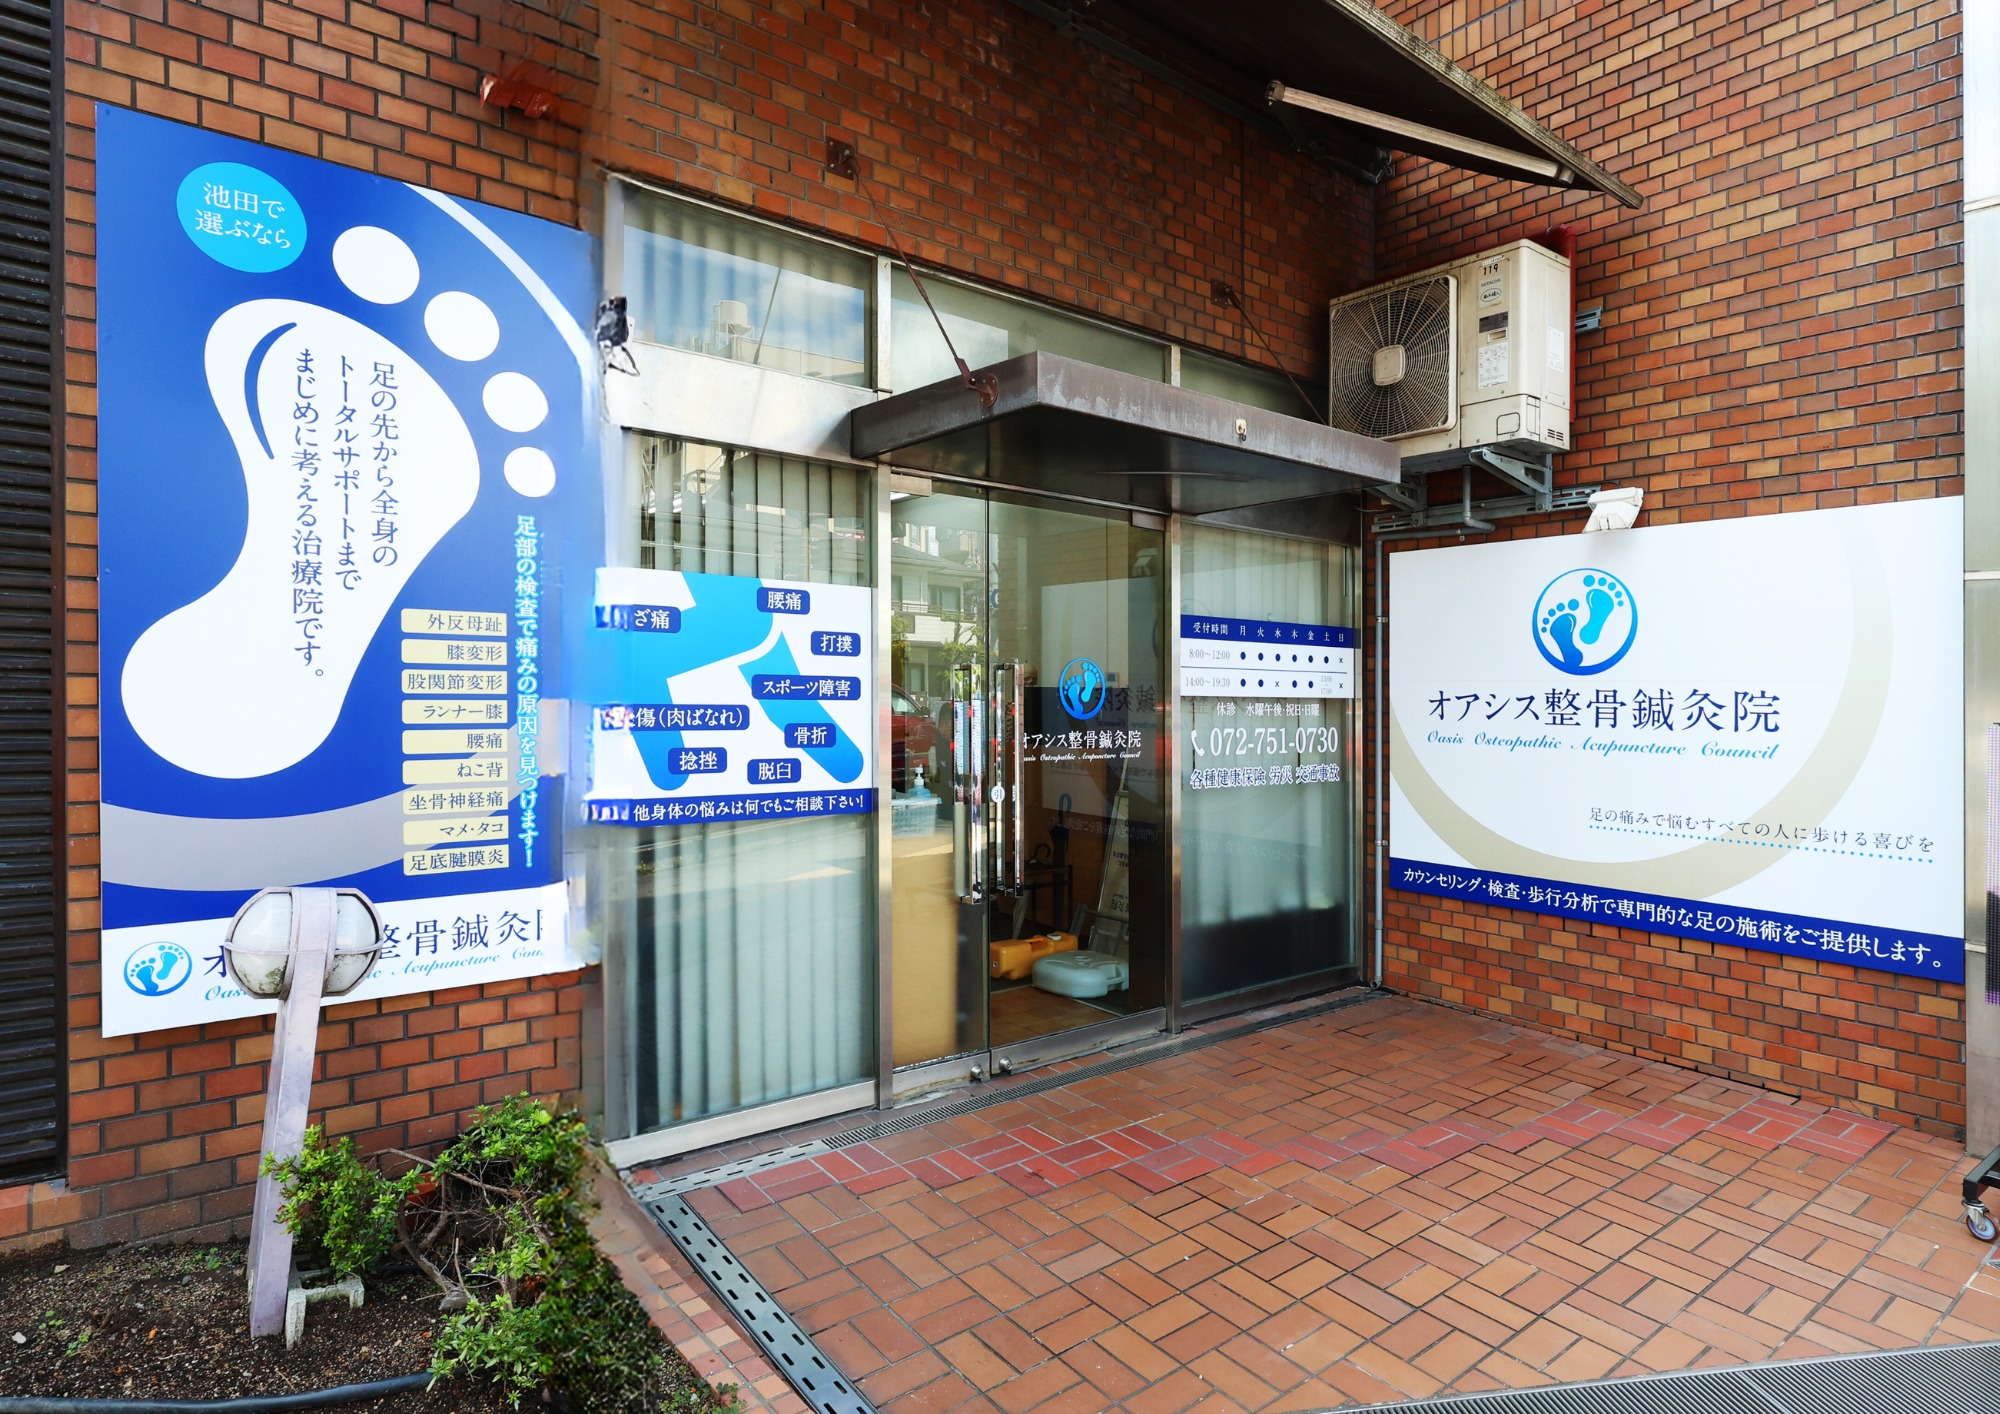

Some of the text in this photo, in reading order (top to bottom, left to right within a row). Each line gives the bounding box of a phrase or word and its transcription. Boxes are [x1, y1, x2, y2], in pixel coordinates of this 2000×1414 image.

[203, 181, 286, 217] 池田で
[195, 208, 292, 249] 選ぶなら
[331, 354, 362, 591] トータルサポートまで
[369, 361, 400, 567] 足の先から全身の
[291, 348, 324, 677] まじめに考える治療院です。
[766, 591, 802, 611] 腰痛
[427, 613, 502, 632] 外反母趾
[632, 608, 670, 630] ざ痛
[1193, 621, 1344, 643] 受付時間 月 火 水 木 金 土 日
[447, 644, 503, 662] 膝変形
[820, 633, 853, 653] 打撲
[407, 673, 503, 691] 股関節変形
[514, 514, 539, 868] 足部の検査で痛みの原因を見つけます！
[762, 679, 851, 698] スポーツ障害
[423, 703, 503, 721] ランナー膝
[633, 707, 743, 728] 傷（肉ばなれ）
[1216, 702, 1236, 716] 休診
[1245, 702, 1320, 717] 水曜午後・祝日・日曜
[1428, 687, 1780, 733] オアシス整骨鍼灸院
[466, 732, 503, 750] 腰痛
[793, 726, 828, 746] 骨折
[1023, 729, 1142, 750] オアシス整骨鍼灸院
[1210, 726, 1339, 757] 072-751-0730
[1427, 730, 1780, 760] Oasis Osteopathic Acupuncture Council
[679, 750, 718, 771] 捻挫
[1023, 750, 1142, 764] asis Osteopathic Acupuncture Council
[457, 761, 503, 778] ねこ背
[758, 762, 793, 781] 脱臼
[1190, 763, 1340, 789] 各種健康保険 労災 交通事故
[409, 791, 503, 810] 坐骨神経痛
[633, 793, 865, 822] 他身体の悩みは何でもご相談下さい！
[439, 822, 504, 837] マメ・タコ
[1588, 806, 1934, 853] 足の痛みで悩むすべての人に歩ける喜びを
[410, 848, 504, 872] 足底腱膜炎
[1403, 867, 1942, 969] カウンセリング・検査・歩行分析で専門的な足の施術をご提供します。
[205, 984, 248, 1001] Oas
[391, 952, 501, 979] Acupuncture
